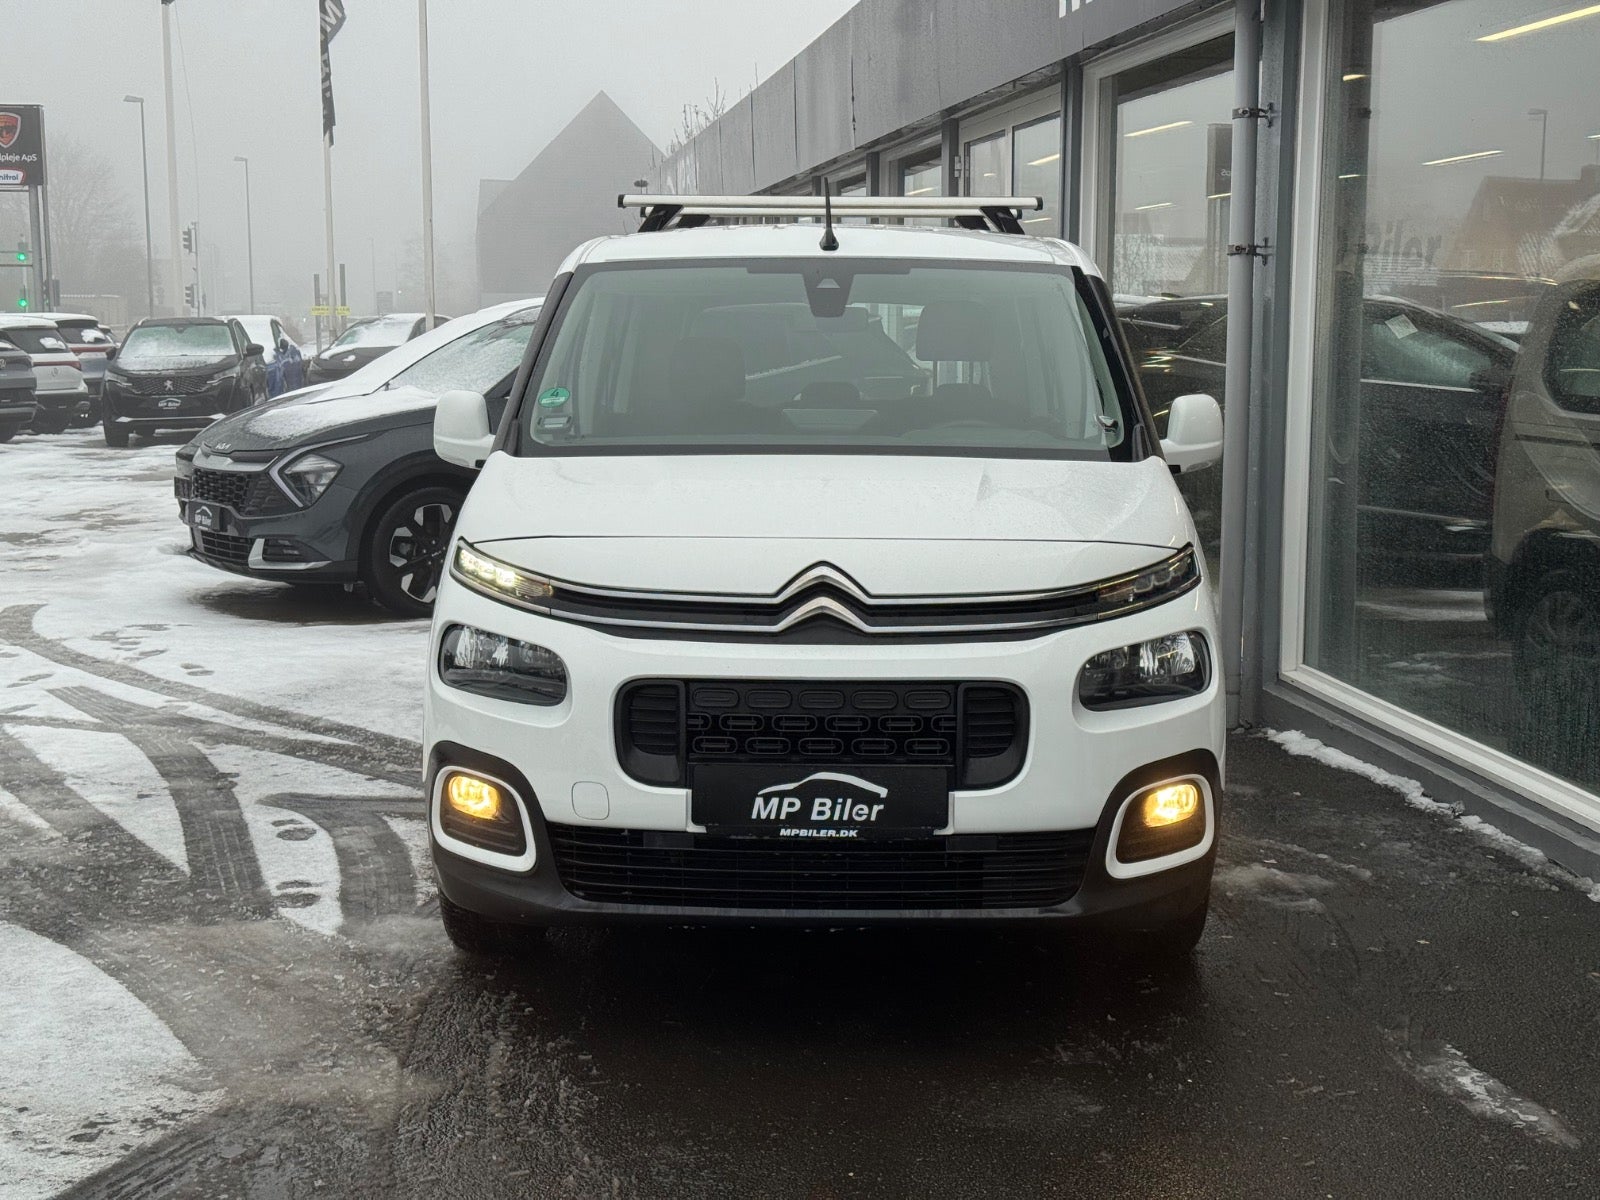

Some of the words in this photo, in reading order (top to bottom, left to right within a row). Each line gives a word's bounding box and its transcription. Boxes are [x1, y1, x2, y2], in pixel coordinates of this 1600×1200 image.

[21, 153, 38, 163] ApS
[550, 388, 559, 397] 4
[751, 796, 801, 820] MP
[810, 797, 885, 822] Biler
[779, 828, 858, 838] MPBILER.DK
